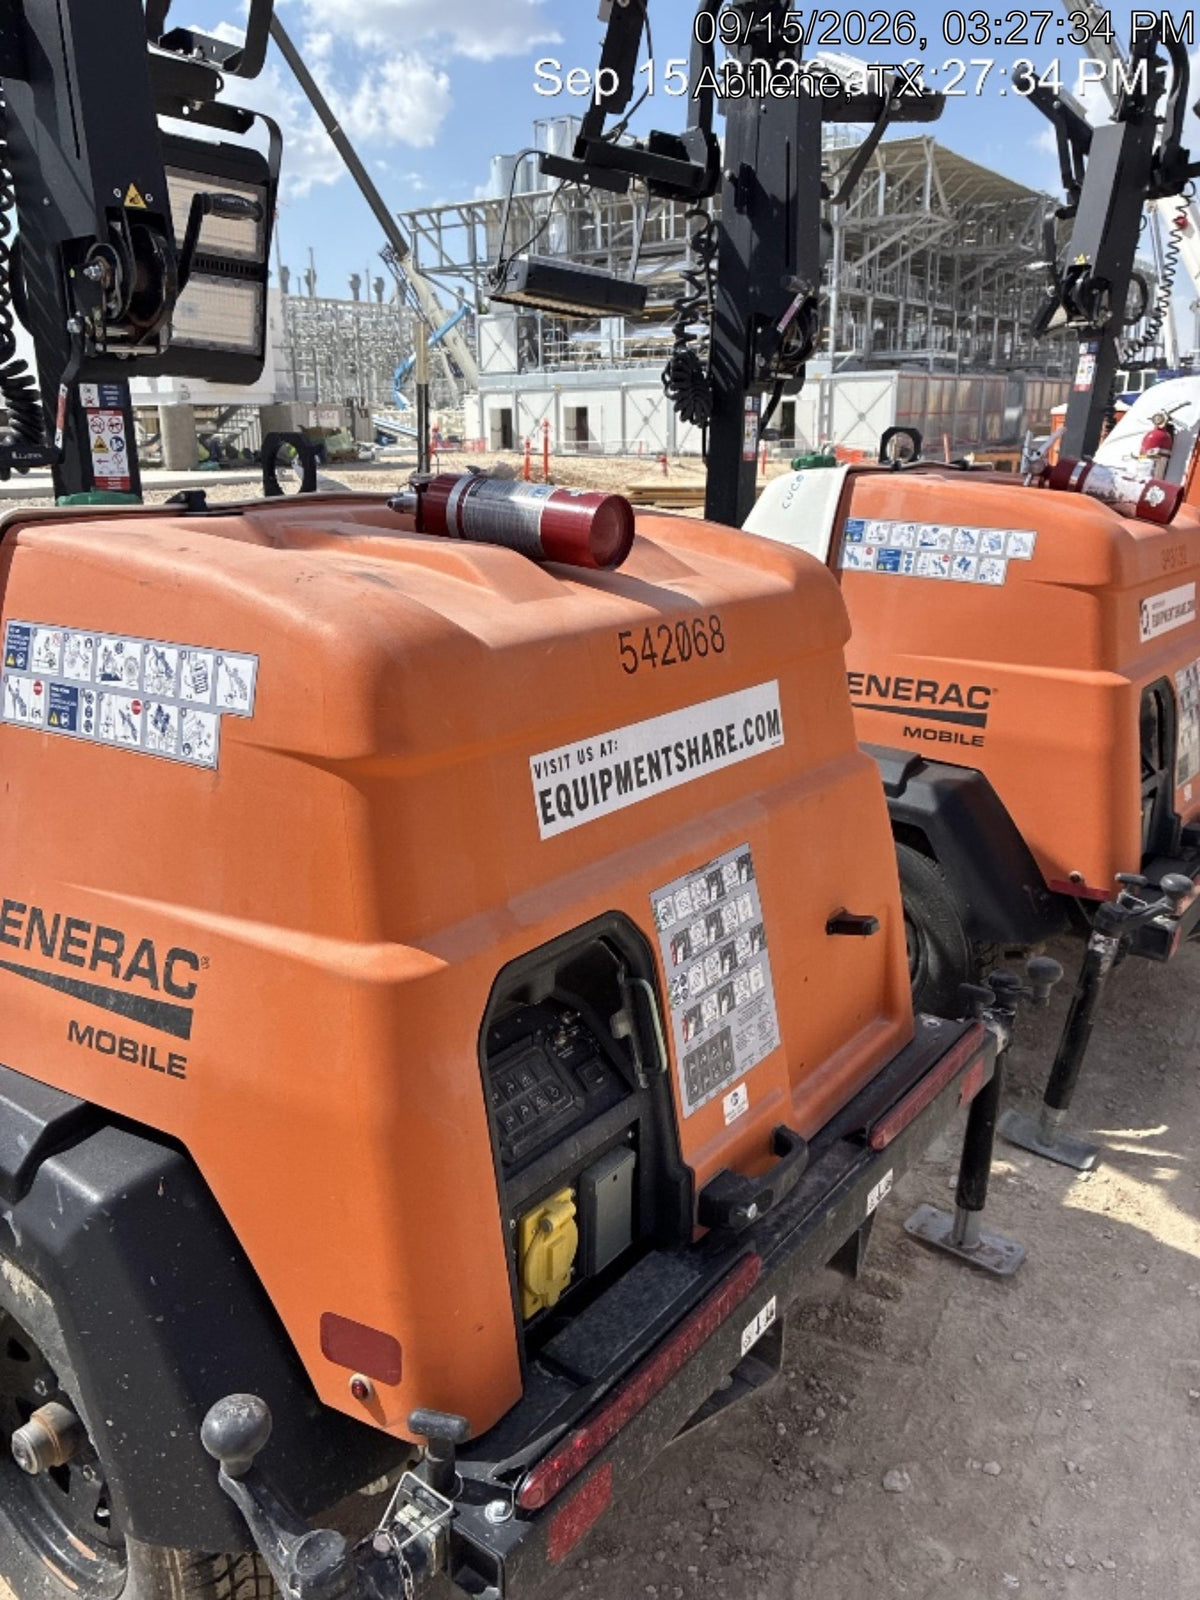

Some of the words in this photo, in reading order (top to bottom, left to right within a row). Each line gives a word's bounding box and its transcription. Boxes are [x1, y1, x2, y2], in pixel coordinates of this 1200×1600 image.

[618, 614, 725, 674] 542068
[533, 754, 571, 779] VISIT
[577, 747, 593, 765] US
[600, 739, 618, 759] AT:
[903, 725, 985, 747] MOBILE
[538, 708, 781, 825] EQUIPMENTSHARE.COM
[67, 1020, 187, 1079] MOBILE
